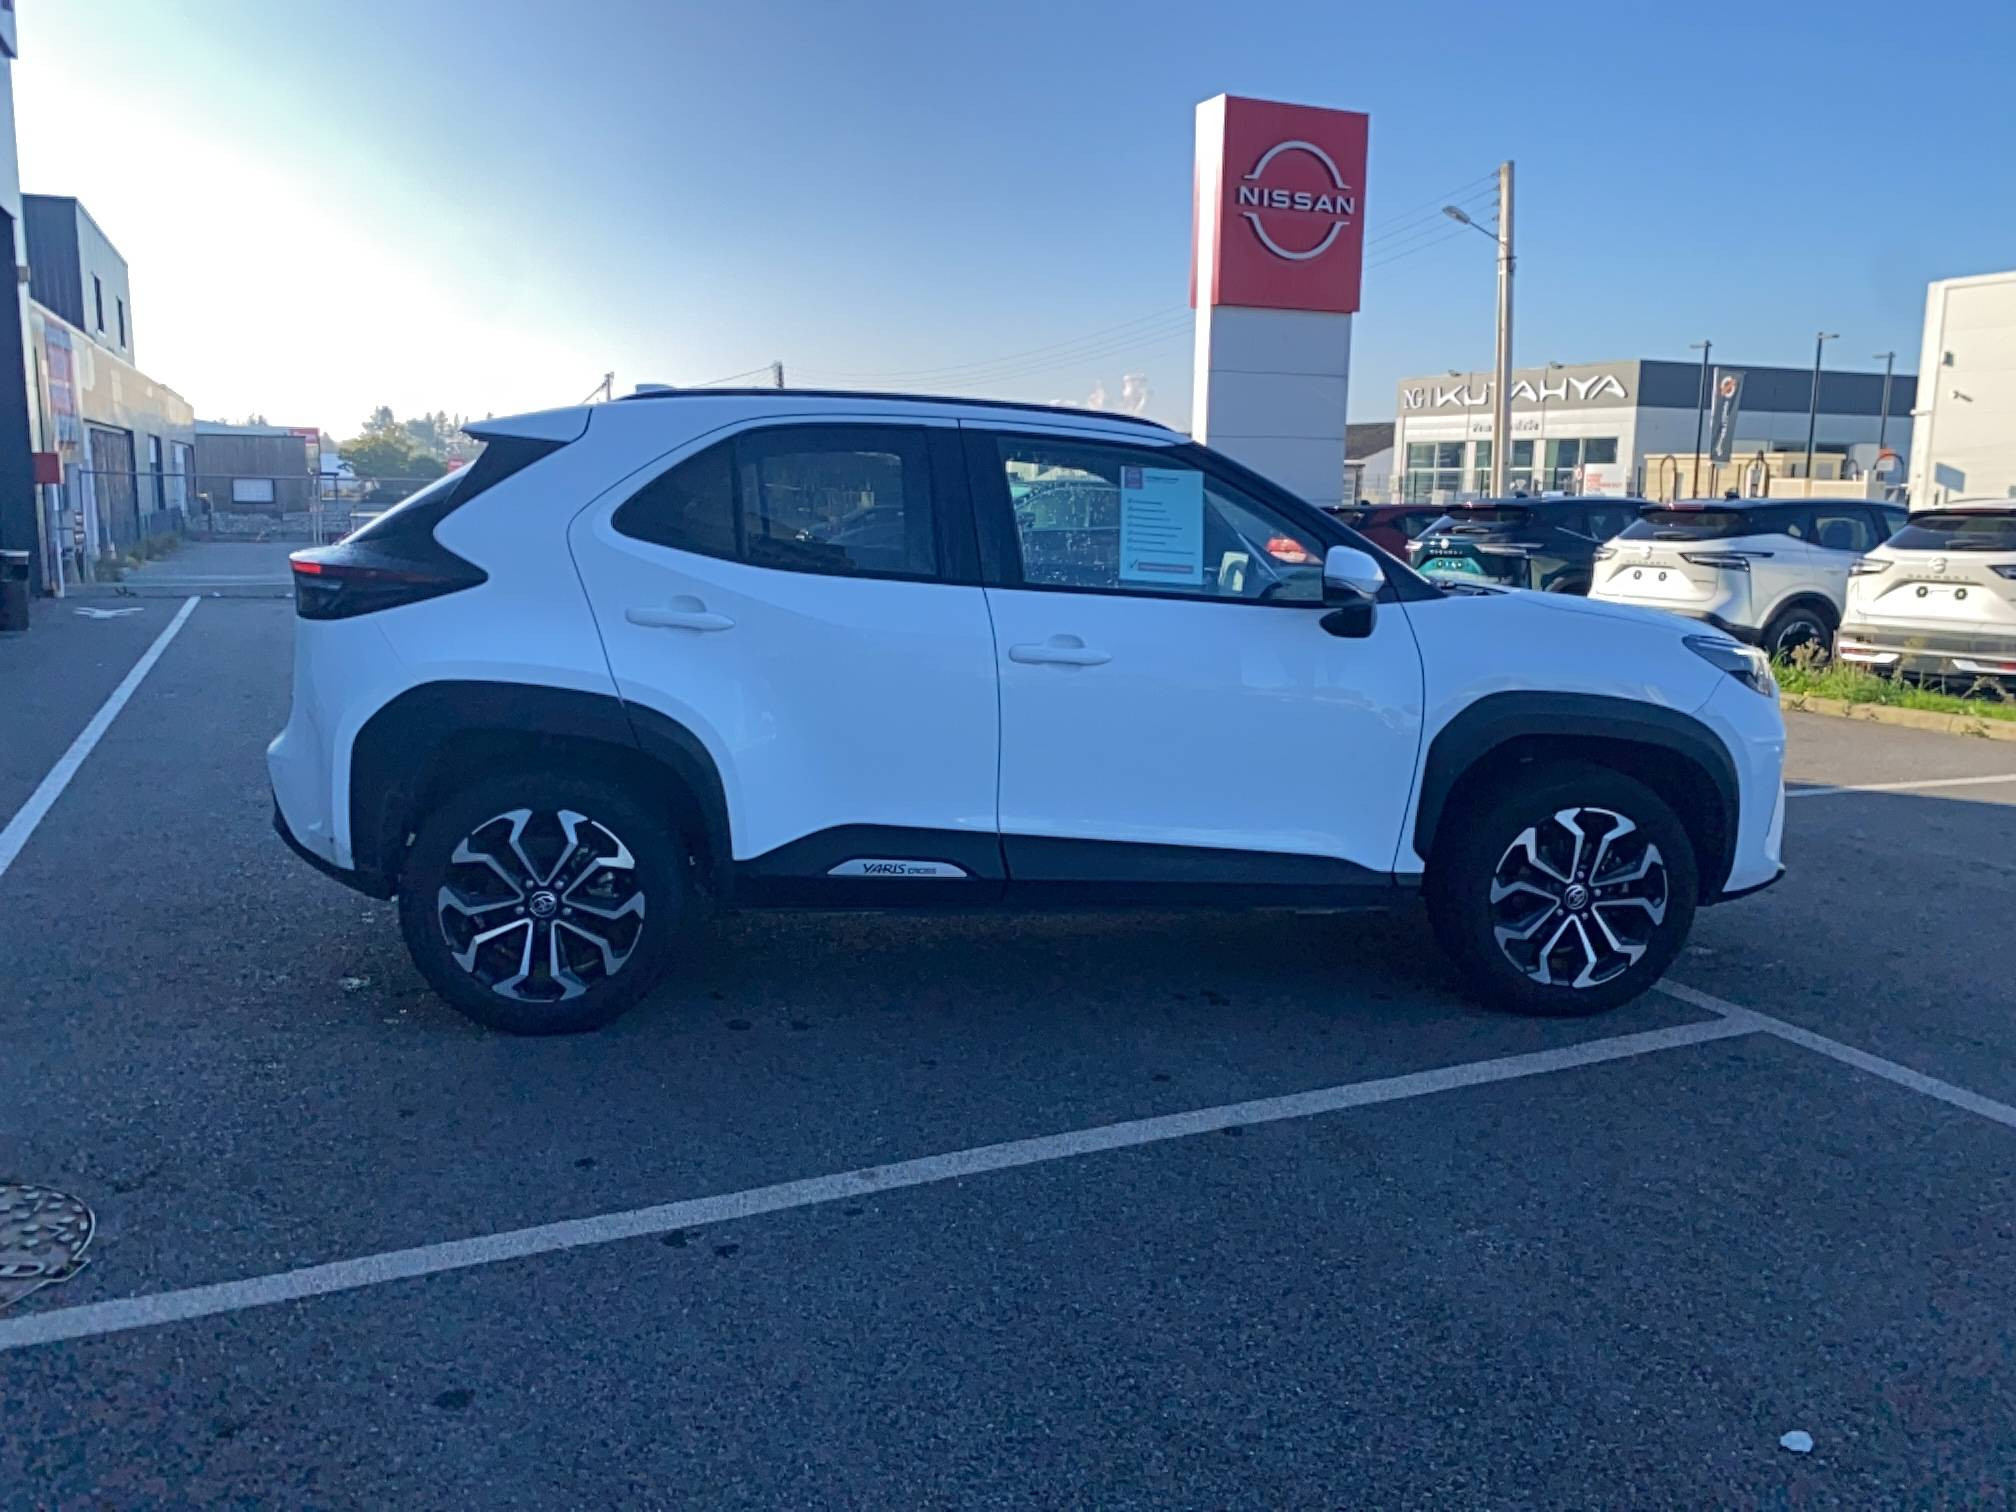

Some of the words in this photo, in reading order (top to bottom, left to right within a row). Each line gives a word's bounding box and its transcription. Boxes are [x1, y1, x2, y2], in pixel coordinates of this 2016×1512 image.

[1239, 186, 1355, 215] NISSAN
[1437, 374, 1628, 408] KUAHYA
[863, 863, 906, 874] YARIS
